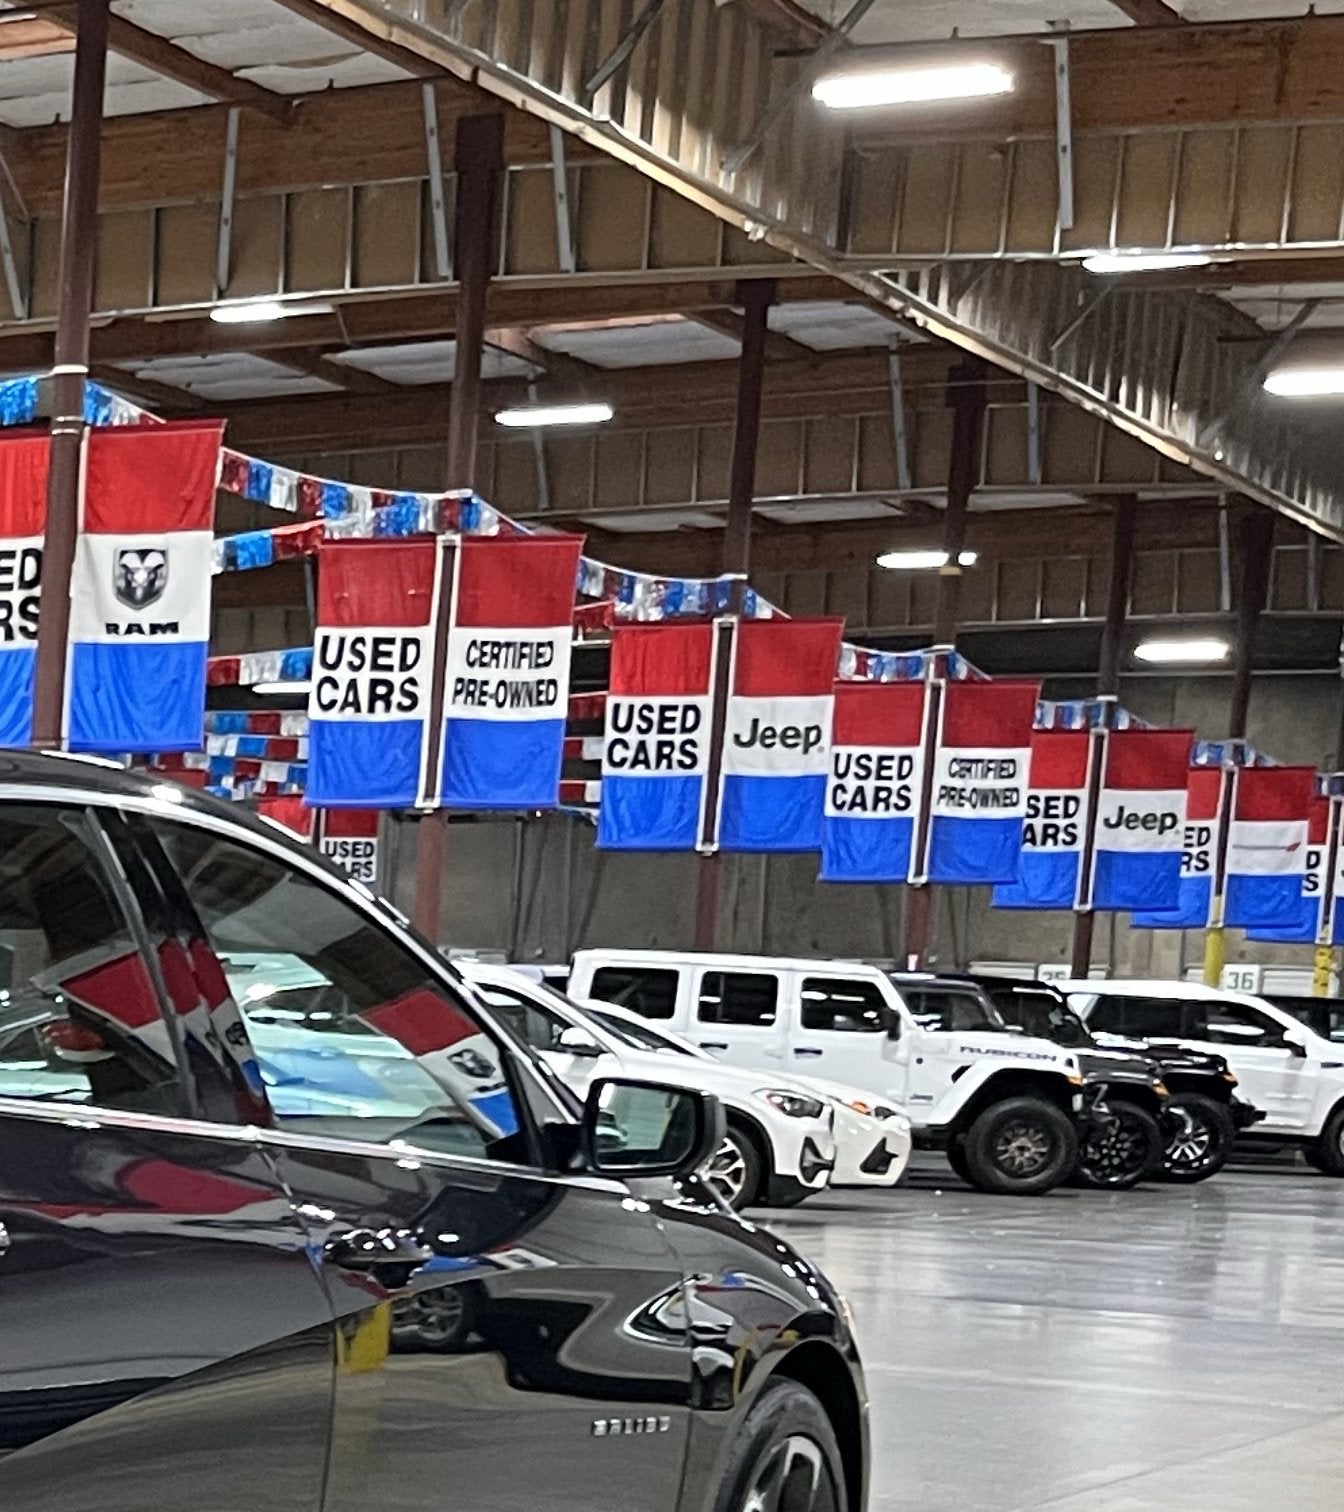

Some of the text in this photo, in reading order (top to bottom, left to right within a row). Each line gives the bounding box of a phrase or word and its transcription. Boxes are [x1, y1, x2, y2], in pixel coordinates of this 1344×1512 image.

[105, 621, 180, 636] RAM
[319, 635, 421, 673] USED
[465, 639, 554, 669] CERTIFIED
[316, 675, 419, 714] CARS
[452, 677, 558, 709] PRE-OWNED
[612, 703, 702, 735] USED
[733, 718, 822, 755] Jeep
[607, 738, 698, 770] CARS
[834, 753, 912, 781] USED
[832, 784, 912, 812] CARS
[937, 785, 1020, 809] PRE-OWNED
[1025, 794, 1080, 820] SED
[1023, 823, 1078, 847] ARS
[1103, 805, 1178, 836] Jeep
[325, 840, 374, 858] USED
[1227, 972, 1254, 991] 36
